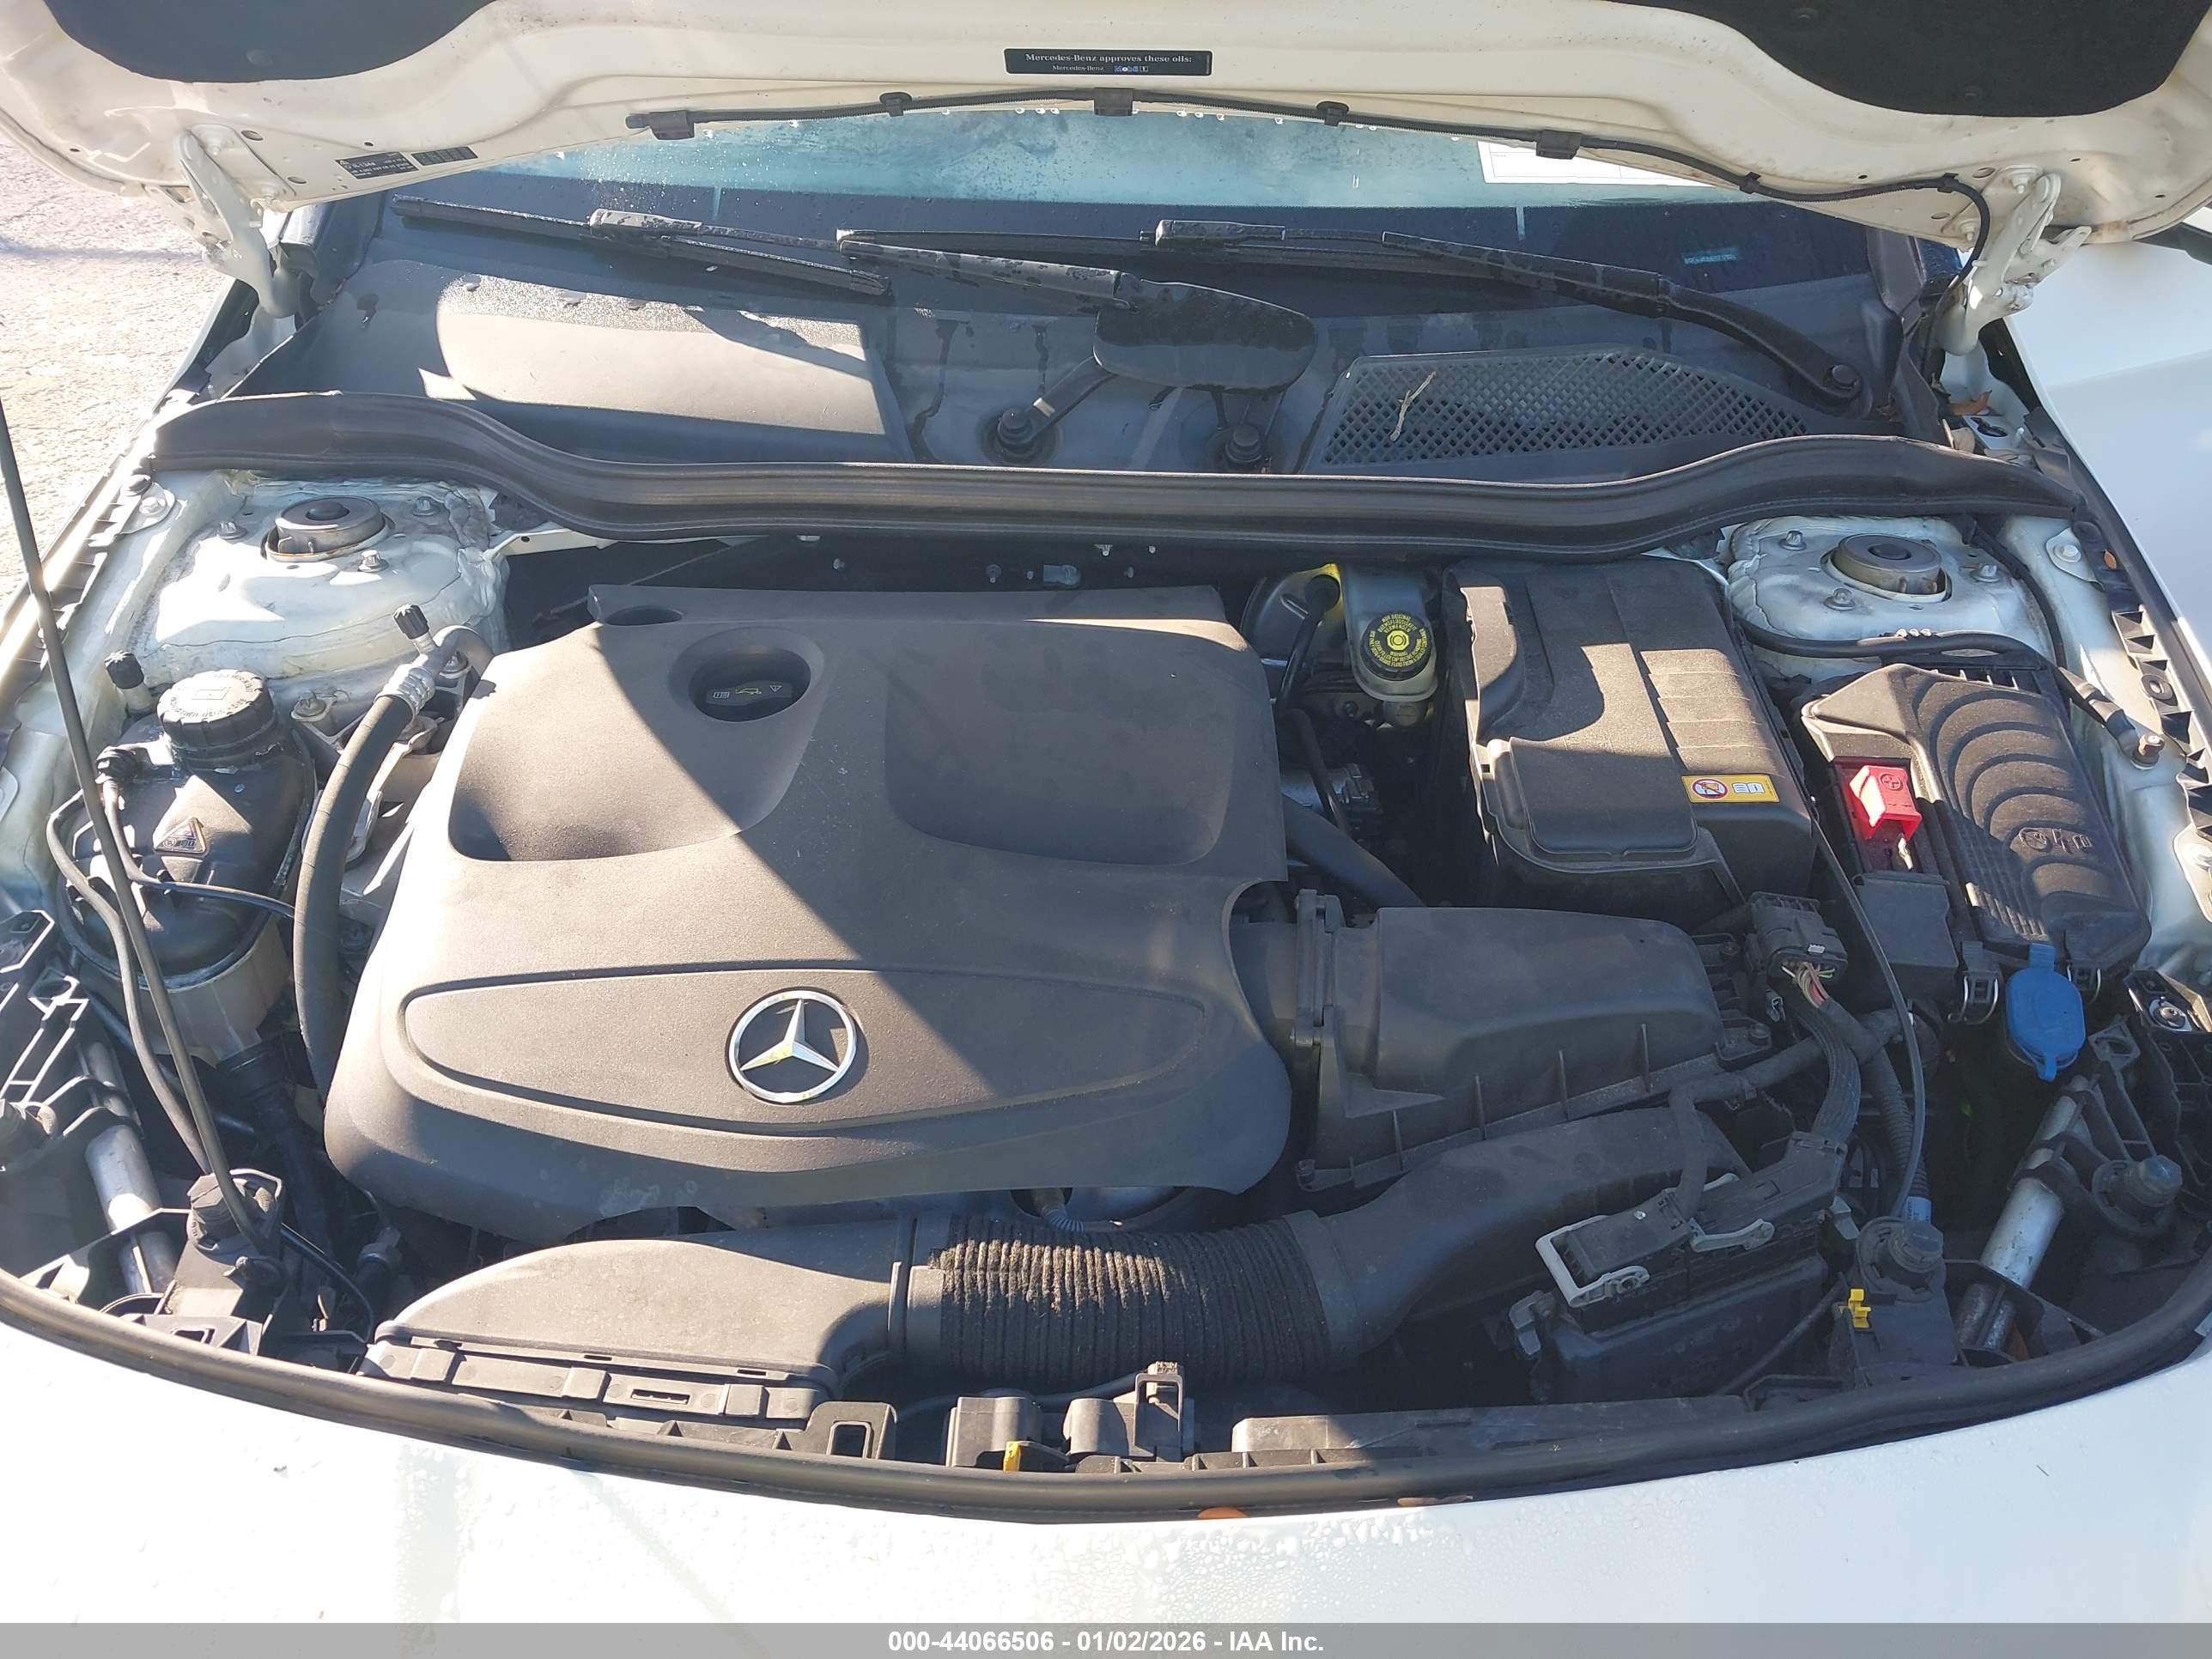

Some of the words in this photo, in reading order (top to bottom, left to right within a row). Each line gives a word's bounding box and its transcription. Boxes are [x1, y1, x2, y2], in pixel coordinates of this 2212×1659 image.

[1025, 53, 1097, 62] Mercedes-Benz
[1099, 54, 1142, 64] approves
[1145, 54, 1170, 63] these
